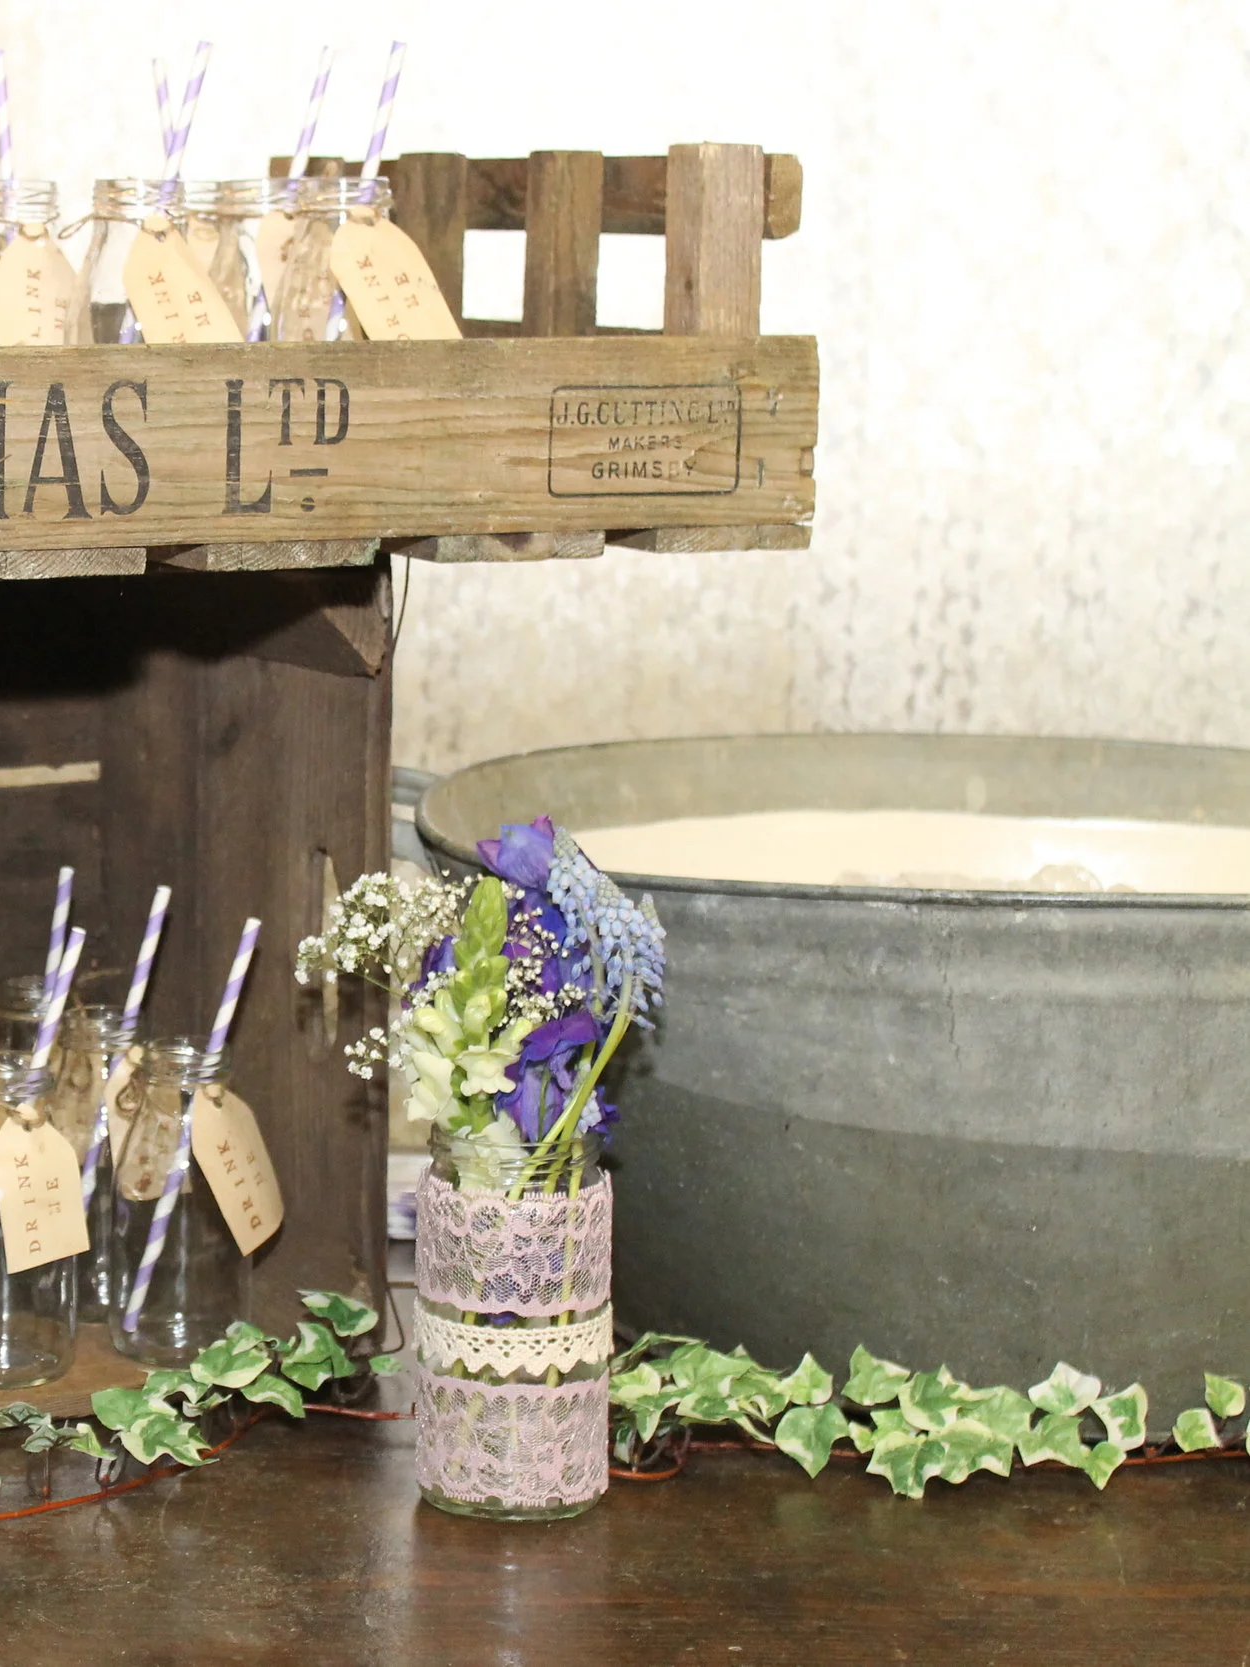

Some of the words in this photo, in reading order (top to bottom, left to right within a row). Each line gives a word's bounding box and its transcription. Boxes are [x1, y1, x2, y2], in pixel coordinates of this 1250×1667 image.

[608, 435, 683, 450] MAKERS
[14, 1153, 42, 1254] DRINK
[217, 1139, 264, 1231] DRINK
